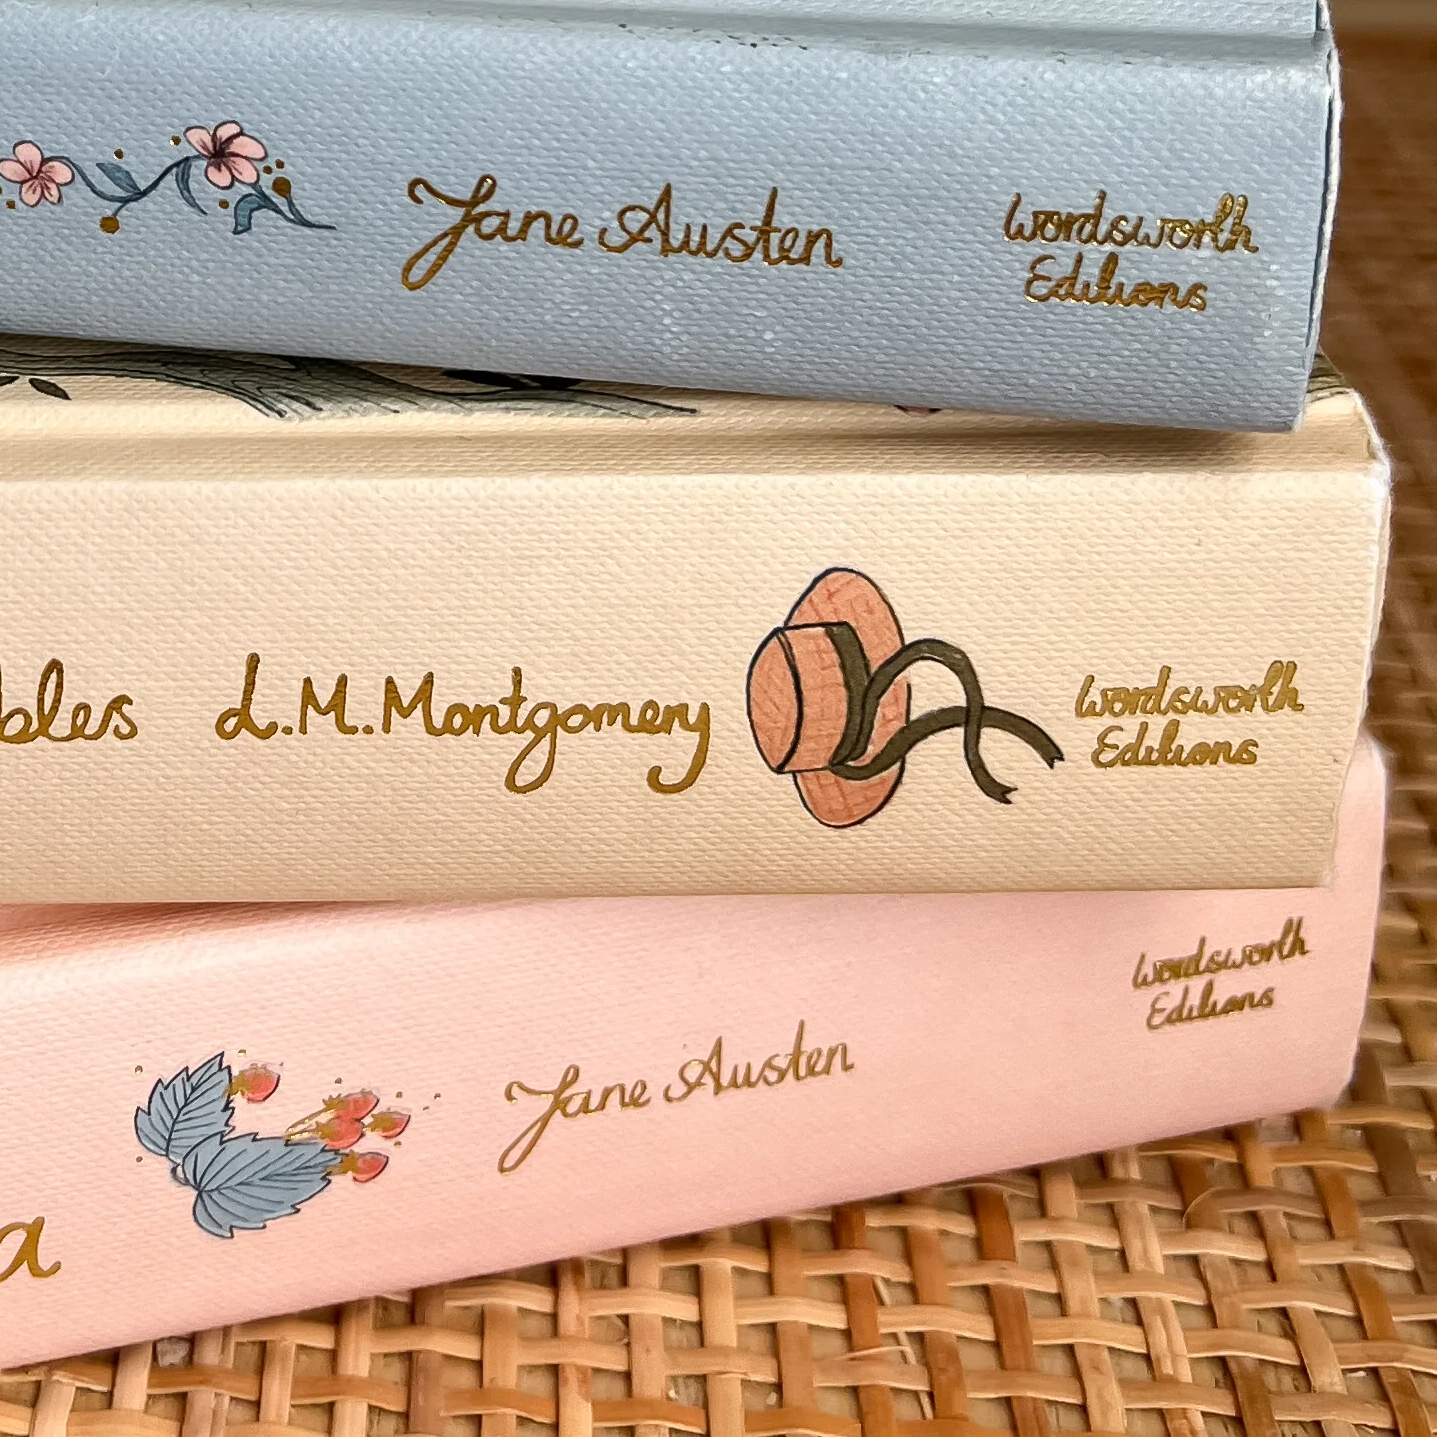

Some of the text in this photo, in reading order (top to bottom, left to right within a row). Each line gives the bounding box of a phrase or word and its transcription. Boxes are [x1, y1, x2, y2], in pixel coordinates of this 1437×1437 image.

[401, 174, 843, 291] Jane Austen
[1023, 251, 1208, 312] Editions
[1091, 719, 1259, 769] Editions
[1147, 978, 1275, 1031] Editions
[498, 1019, 855, 1175] Jane Austen
